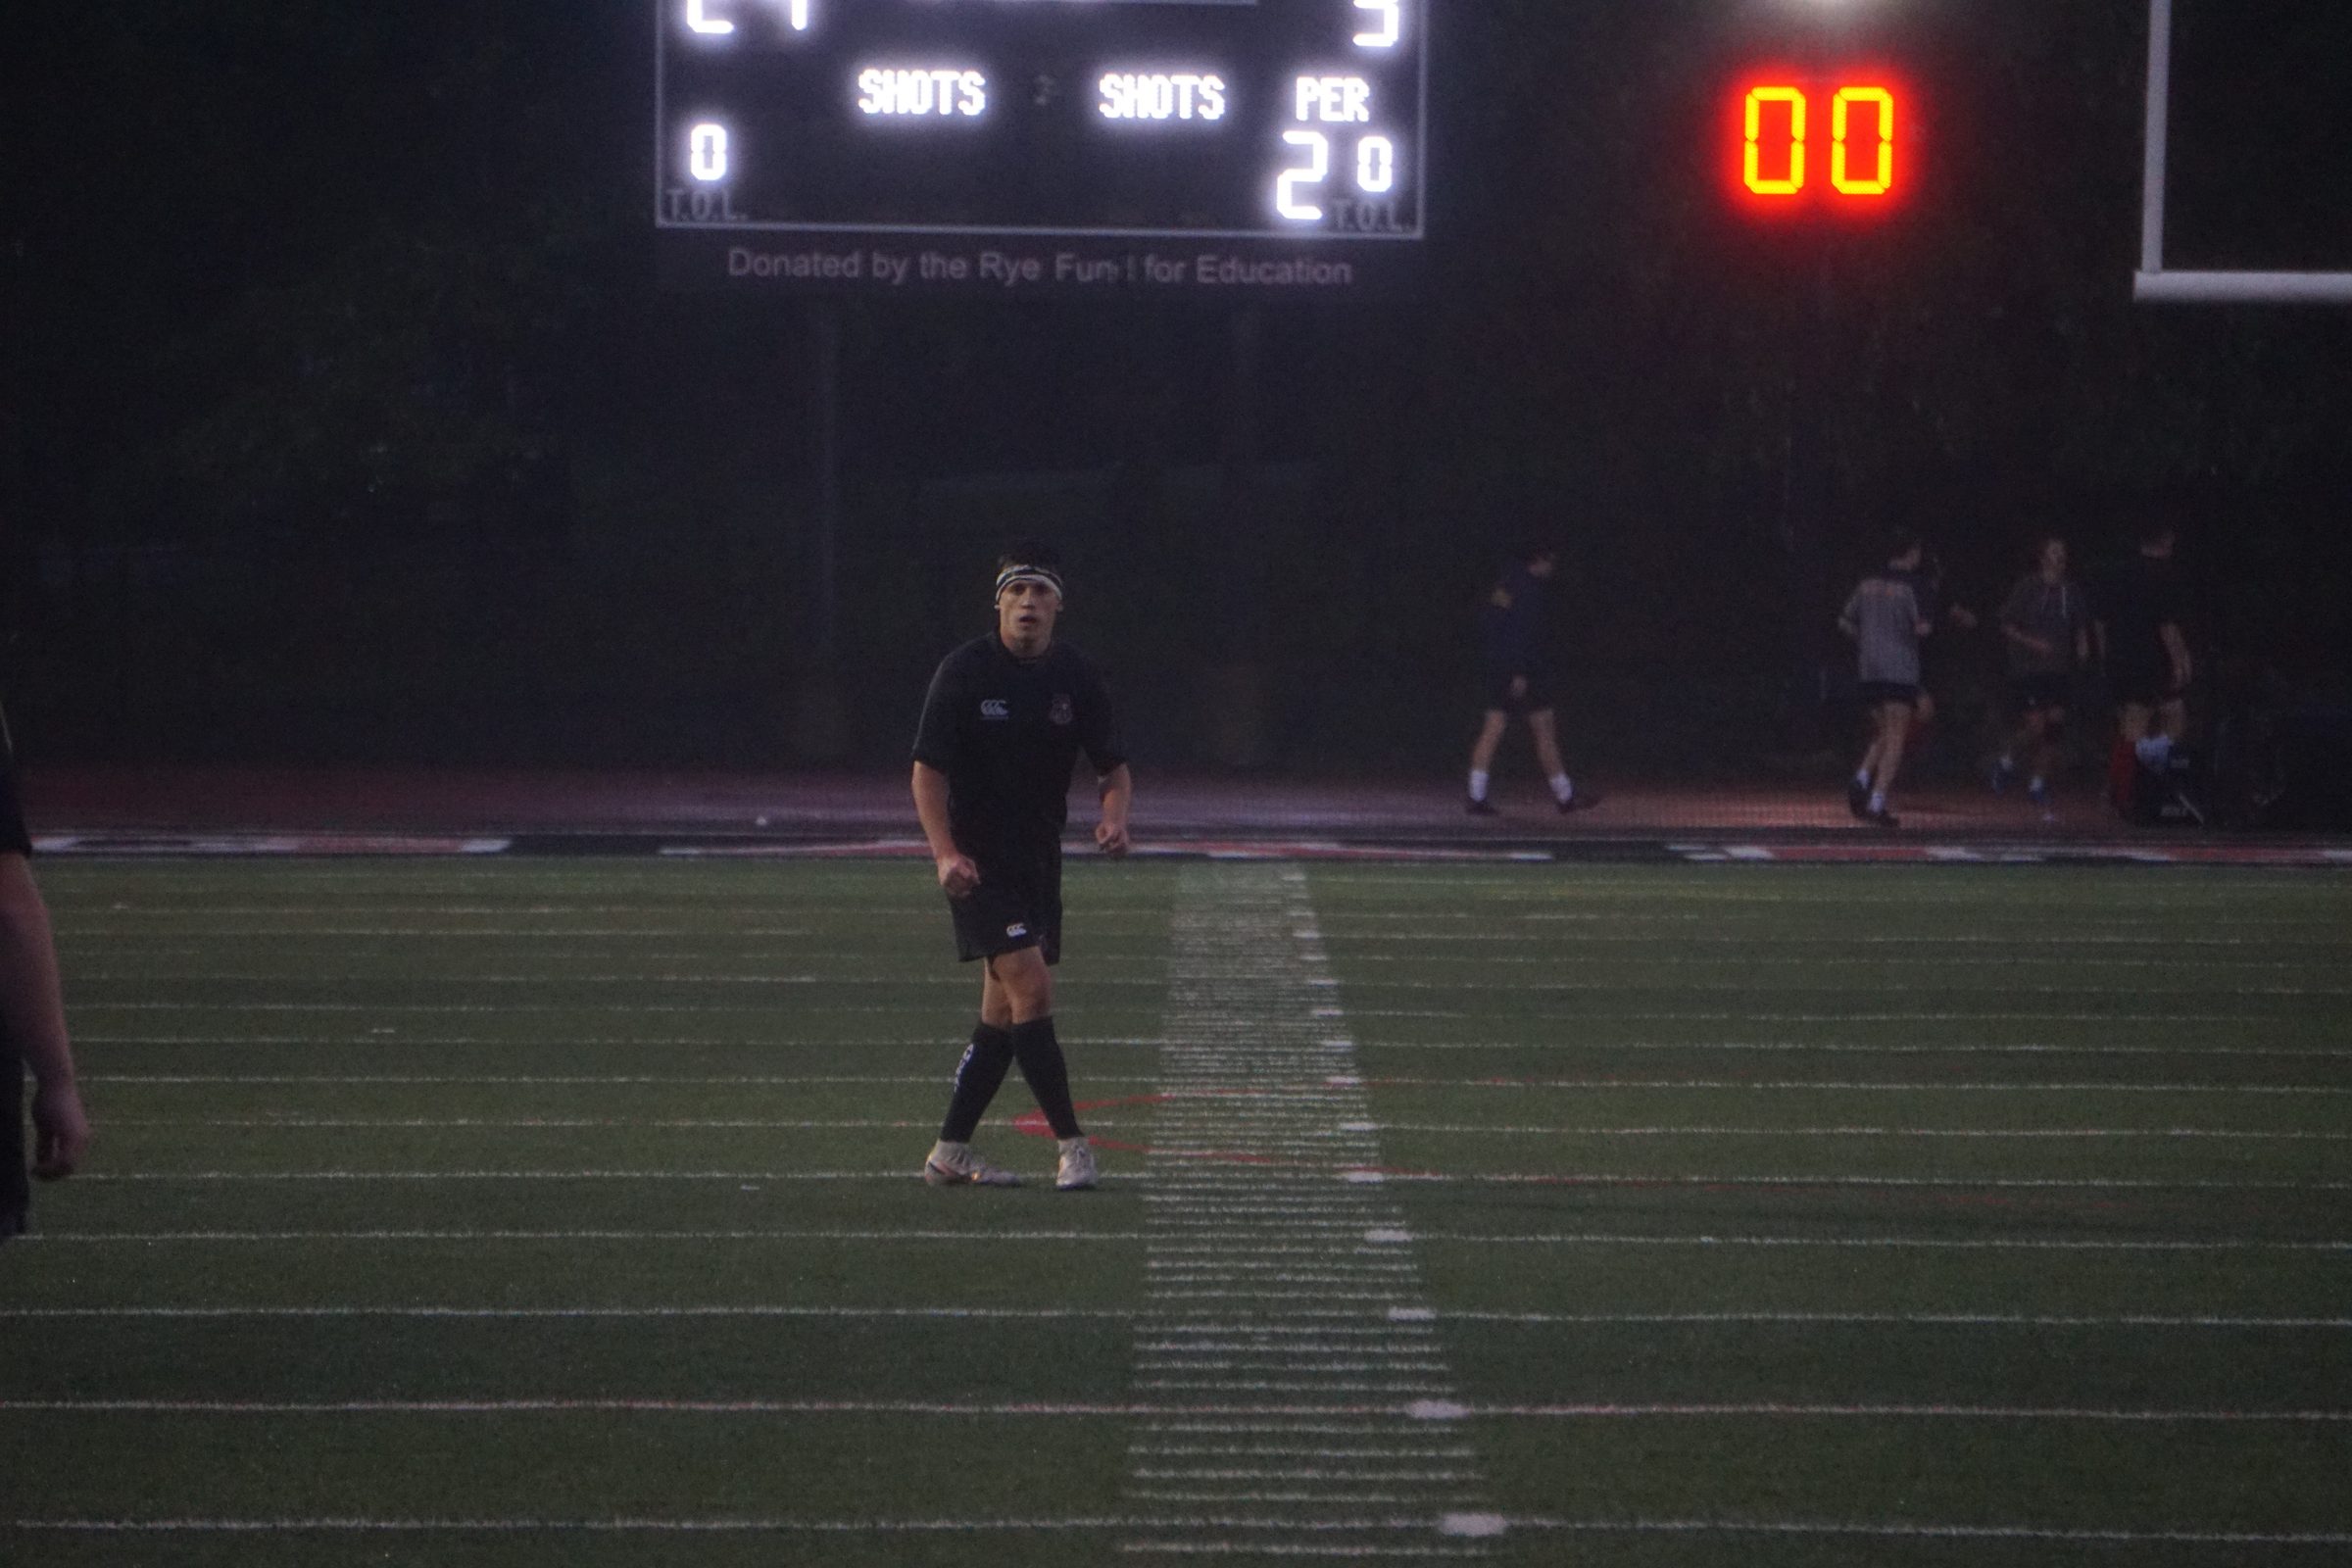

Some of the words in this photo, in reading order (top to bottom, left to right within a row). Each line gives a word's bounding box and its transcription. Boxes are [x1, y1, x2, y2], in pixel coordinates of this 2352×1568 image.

[858, 68, 986, 117] SHOTS
[1099, 74, 1226, 121] SHOTS
[1295, 75, 1370, 122] PER
[690, 123, 728, 181] 0
[1356, 135, 1394, 193] 0
[1743, 86, 1894, 195] 00
[1275, 129, 1330, 220] 2
[728, 247, 859, 277] Donated
[872, 251, 908, 285] by
[919, 251, 967, 279] the
[980, 251, 1041, 286] Rye
[1144, 253, 1186, 284] for
[1196, 254, 1352, 285] Education
